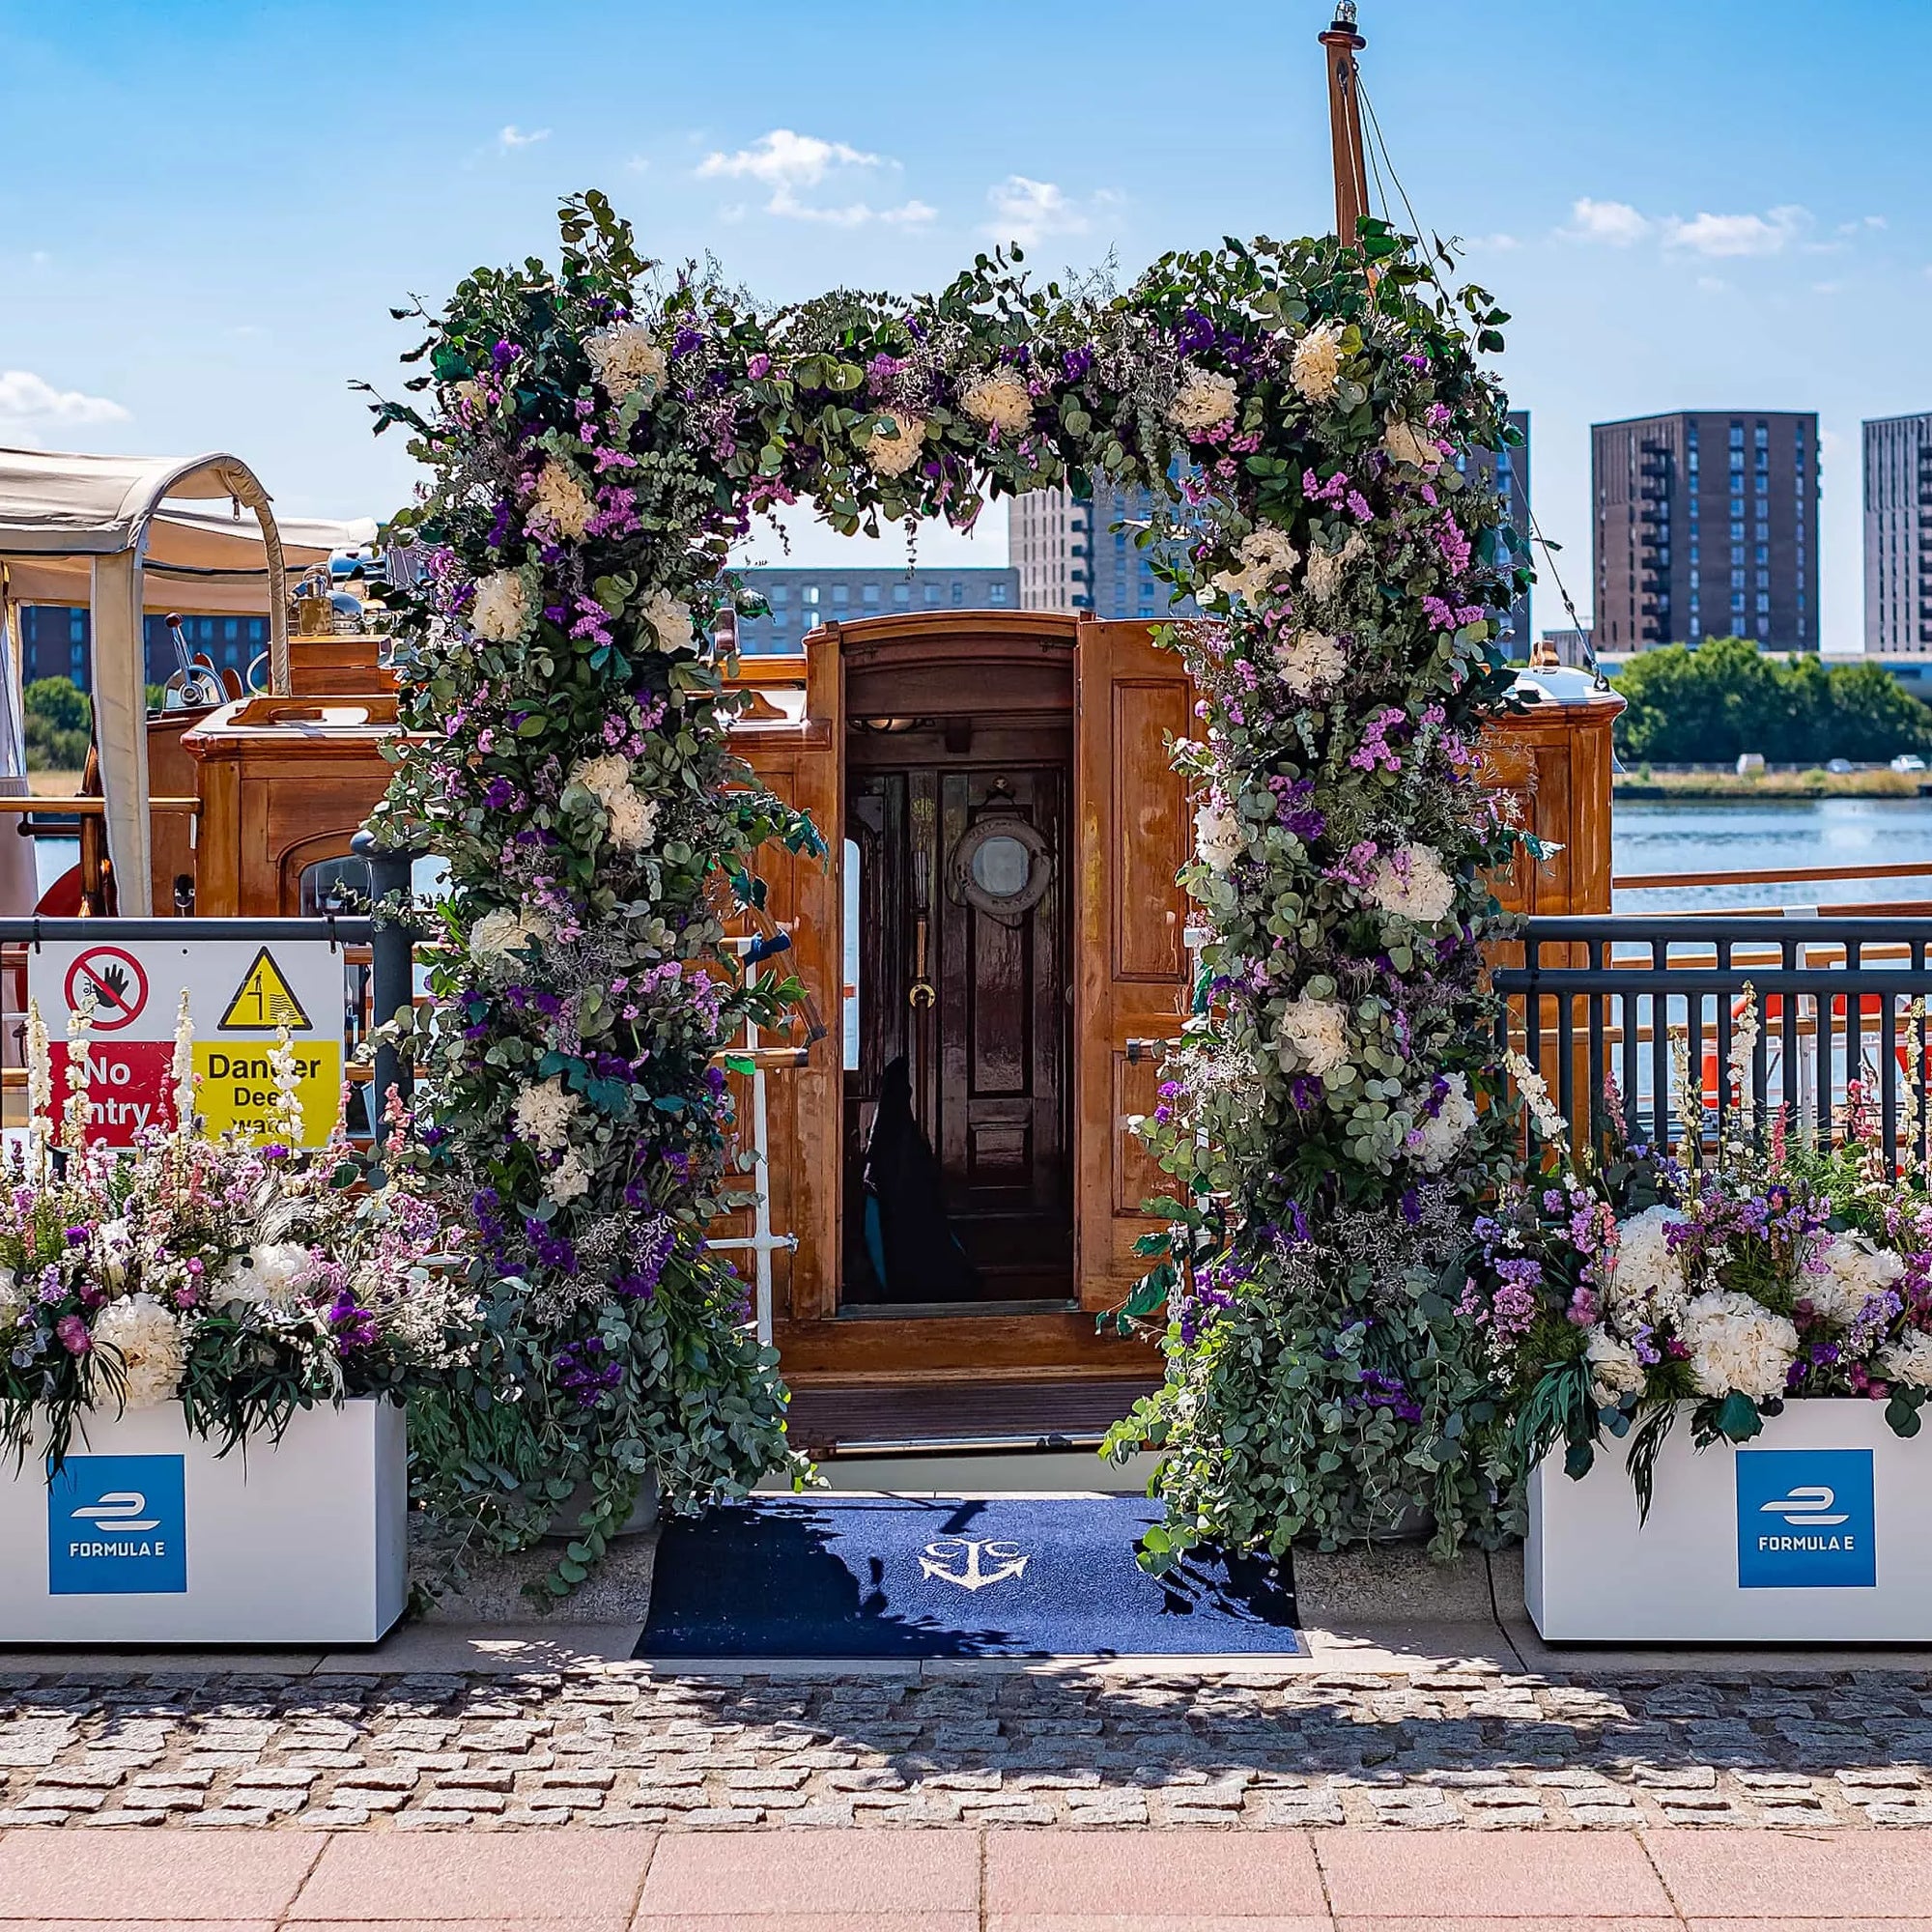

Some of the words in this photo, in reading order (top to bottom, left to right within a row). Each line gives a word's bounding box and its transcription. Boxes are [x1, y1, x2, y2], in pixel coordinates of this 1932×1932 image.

[83, 1056, 131, 1085] No
[234, 1087, 293, 1107] Dee
[69, 1542, 152, 1558] FORMULA
[155, 1541, 165, 1556] E
[1758, 1535, 1840, 1551] FORMULA
[1844, 1535, 1855, 1550] E
